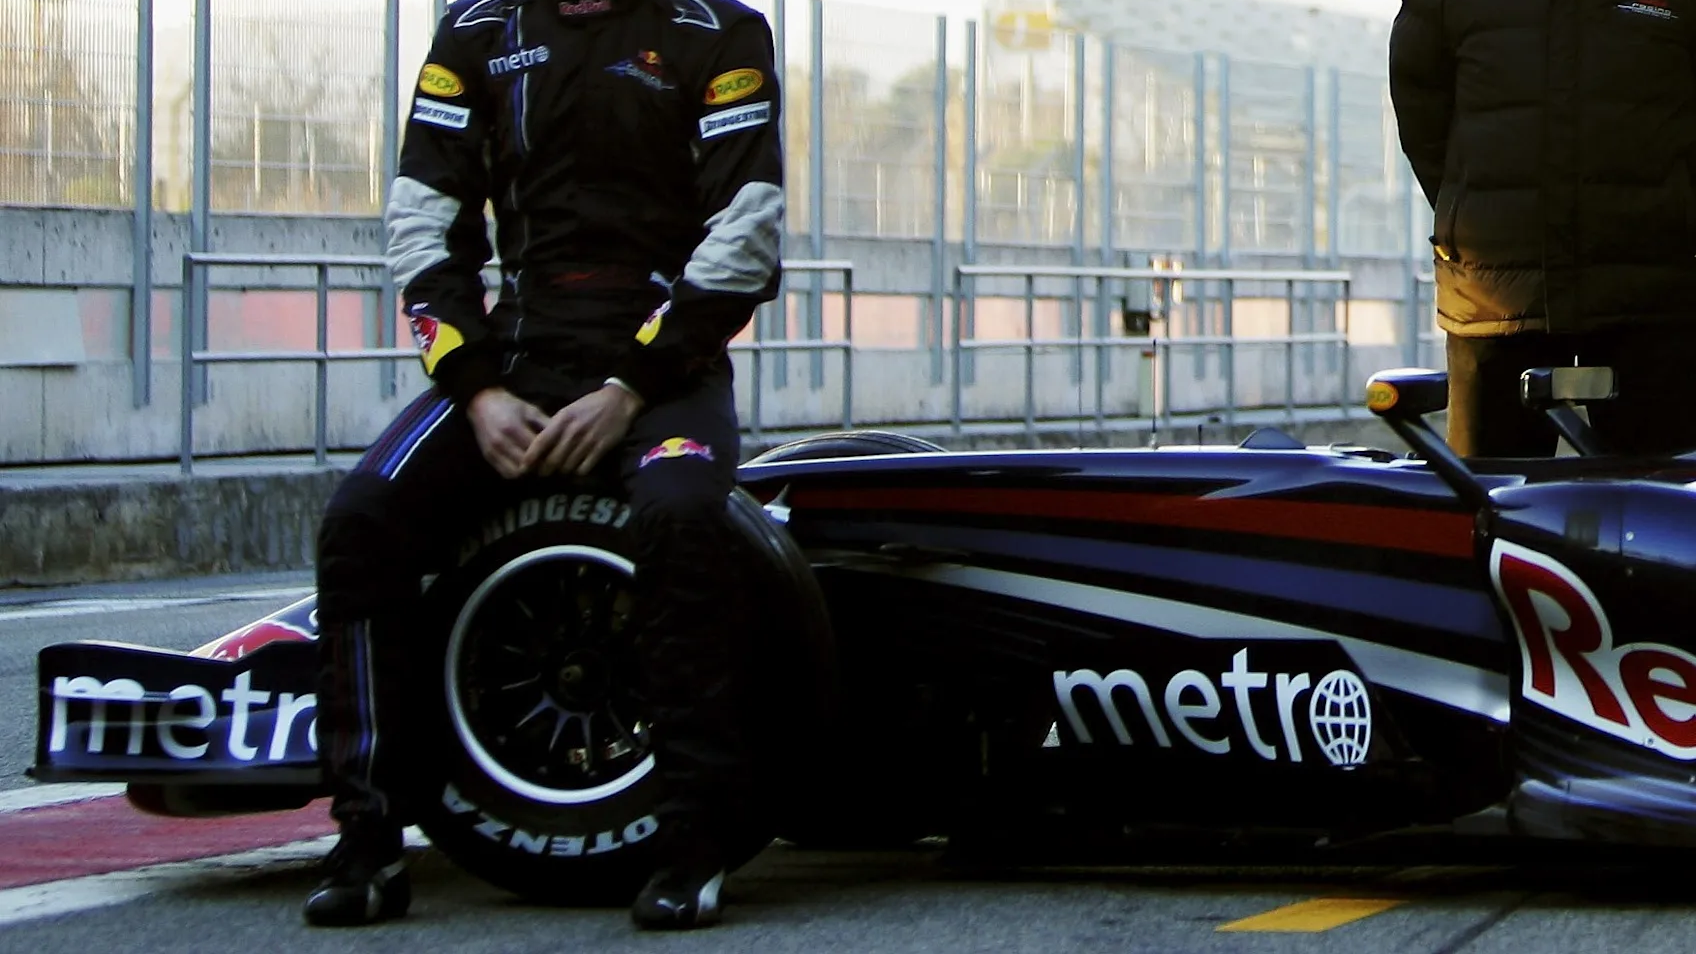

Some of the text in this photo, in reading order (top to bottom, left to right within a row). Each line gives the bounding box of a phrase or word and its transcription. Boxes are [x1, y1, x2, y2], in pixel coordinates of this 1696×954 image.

[488, 45, 550, 75] metro
[716, 75, 755, 95] RAUCH
[49, 670, 318, 761] metr
[1053, 647, 1372, 769] metro
[441, 782, 660, 857] OTENZA
